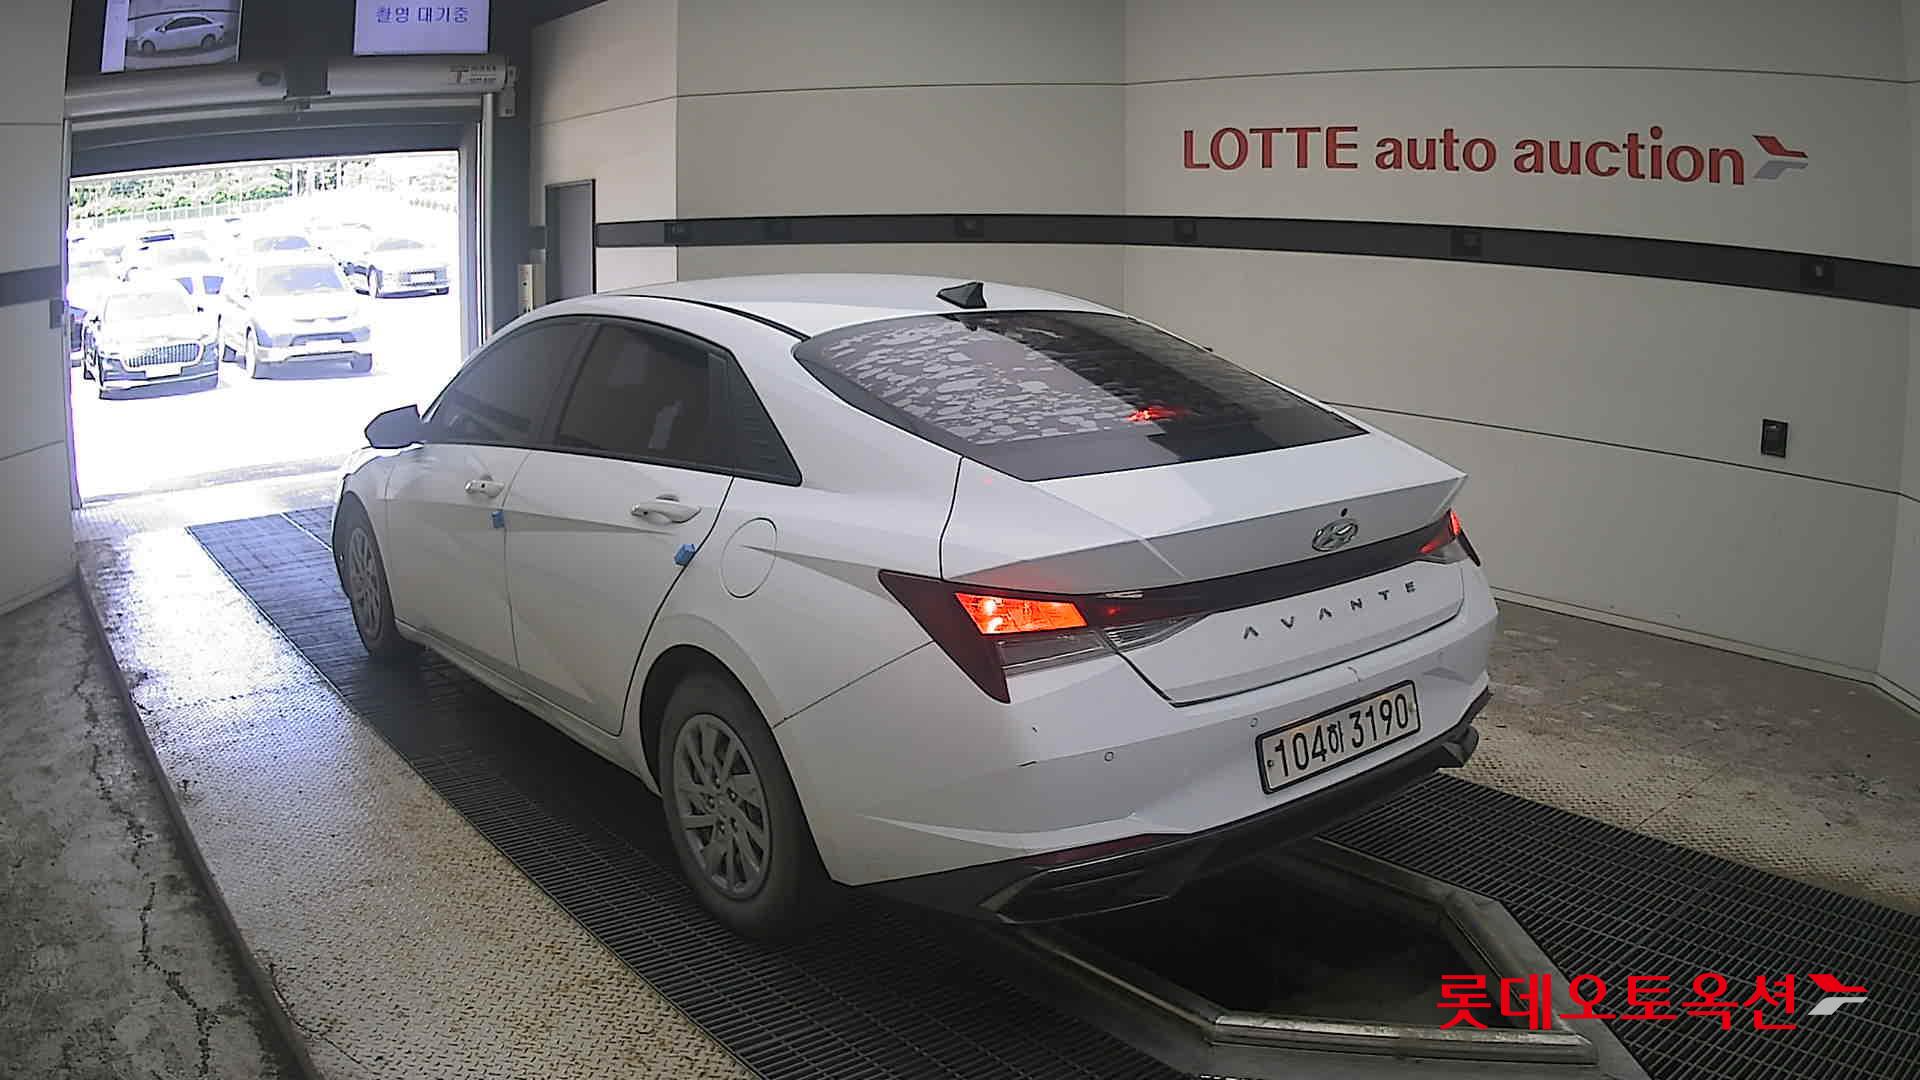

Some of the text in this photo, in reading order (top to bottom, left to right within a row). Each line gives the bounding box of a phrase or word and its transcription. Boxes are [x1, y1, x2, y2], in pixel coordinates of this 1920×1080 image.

[375, 6, 469, 24] 촬영 대기중
[1183, 125, 1745, 186] LOTTE auto auction
[1243, 580, 1416, 640] AVANTE
[1348, 693, 1409, 748] 3190
